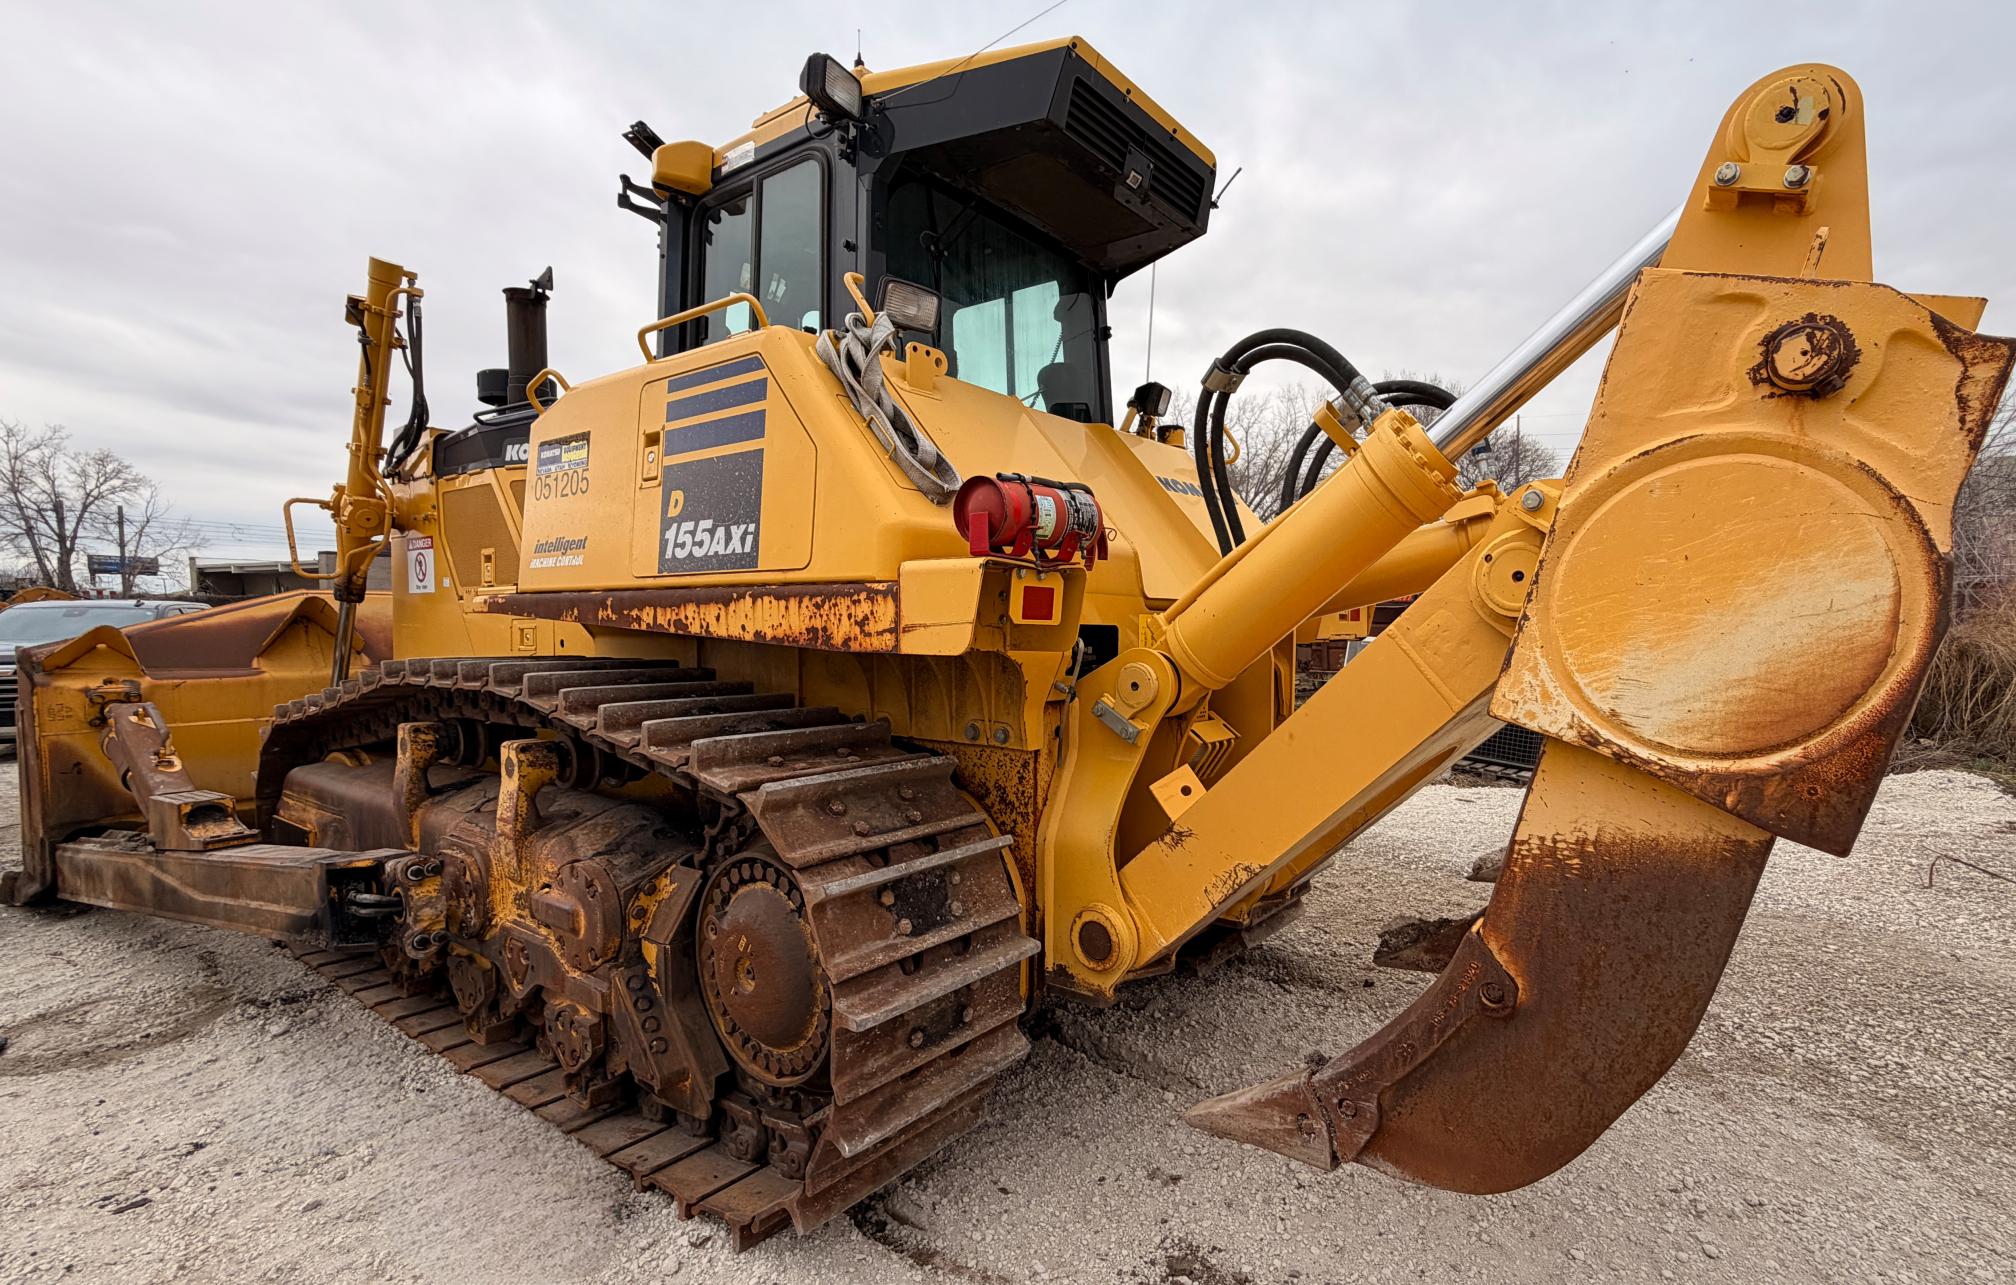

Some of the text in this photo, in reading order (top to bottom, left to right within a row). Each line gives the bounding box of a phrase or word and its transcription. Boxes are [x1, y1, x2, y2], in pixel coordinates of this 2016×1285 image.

[534, 468, 589, 501] 051205
[667, 489, 684, 518] D
[412, 537, 432, 549] DANGER
[534, 536, 588, 555] intelligent
[665, 519, 755, 559] 155AXi
[529, 554, 584, 569] MACHINE CONTROL
